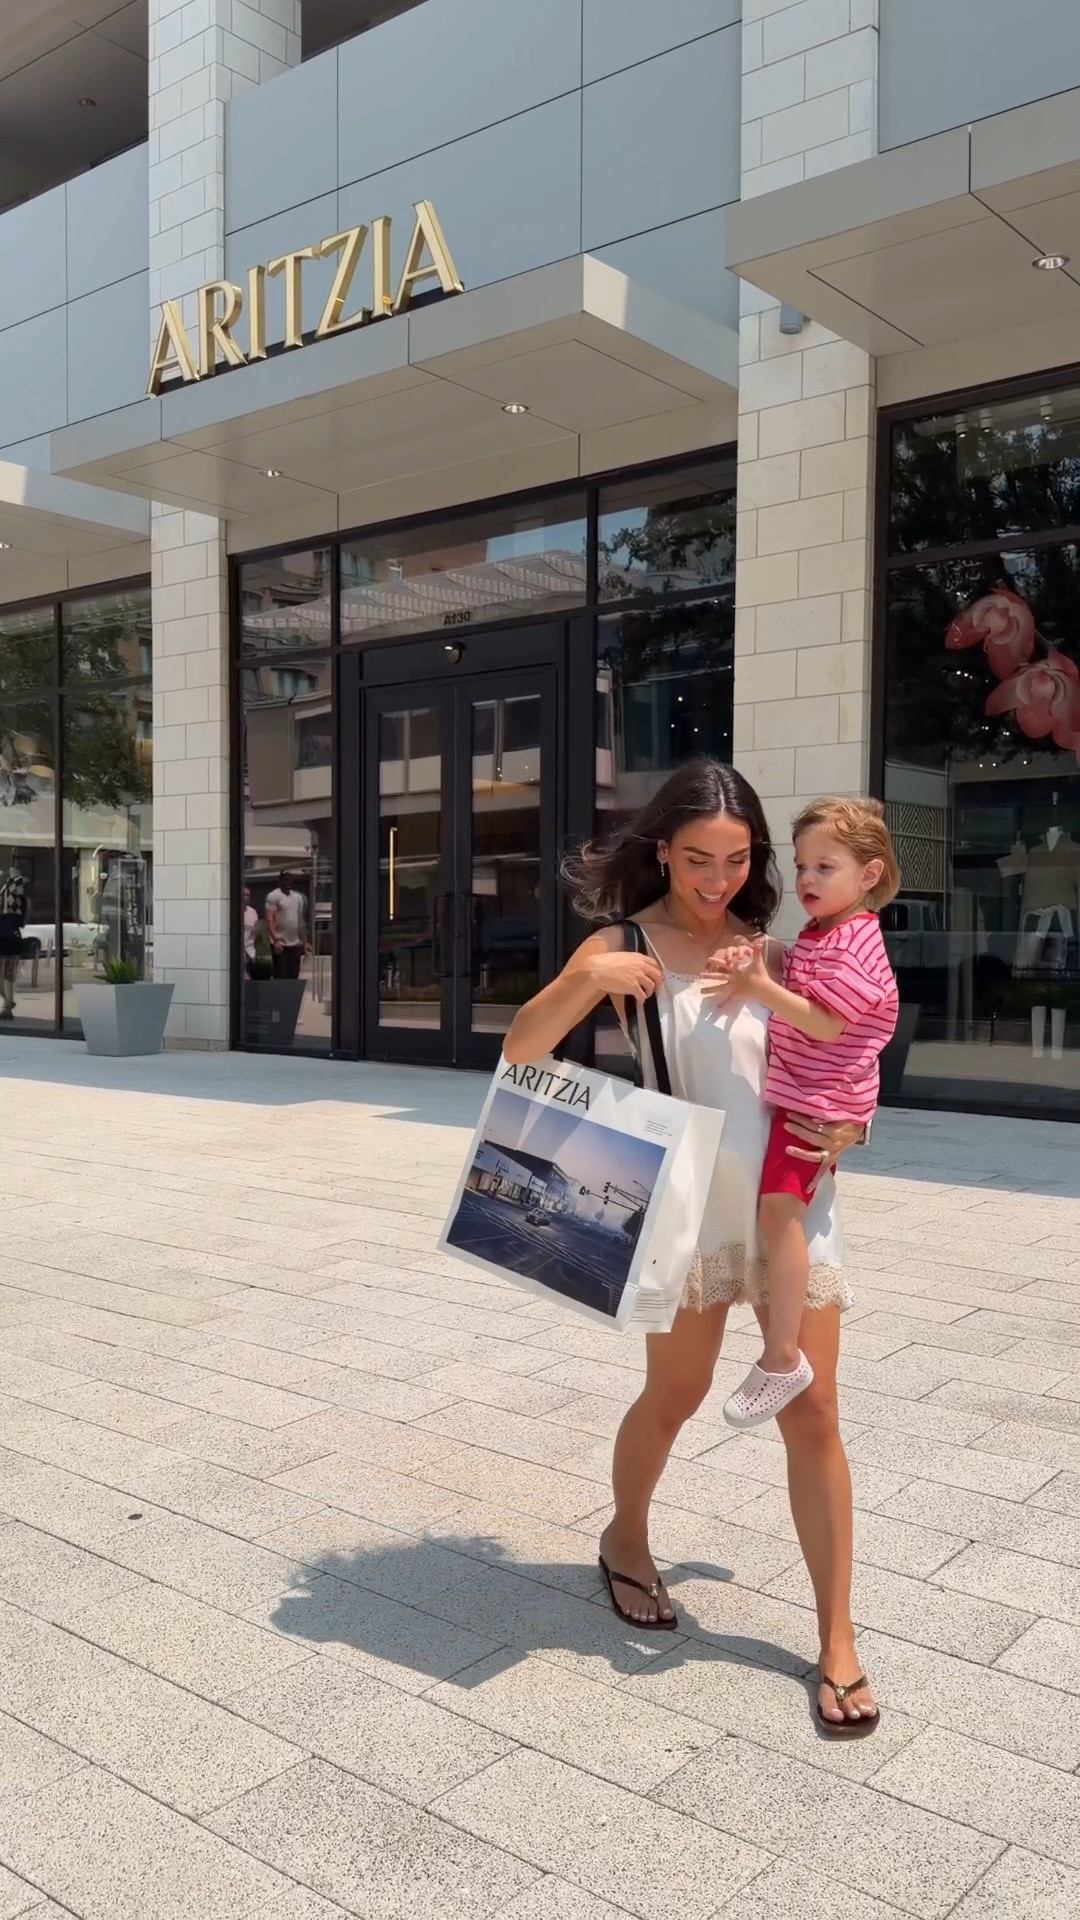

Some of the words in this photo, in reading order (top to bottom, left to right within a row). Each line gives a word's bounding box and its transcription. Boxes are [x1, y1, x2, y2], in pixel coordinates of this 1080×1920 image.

[145, 199, 465, 399] ARITZIA
[443, 610, 471, 626] A130
[500, 1063, 591, 1111] ARITZIA
